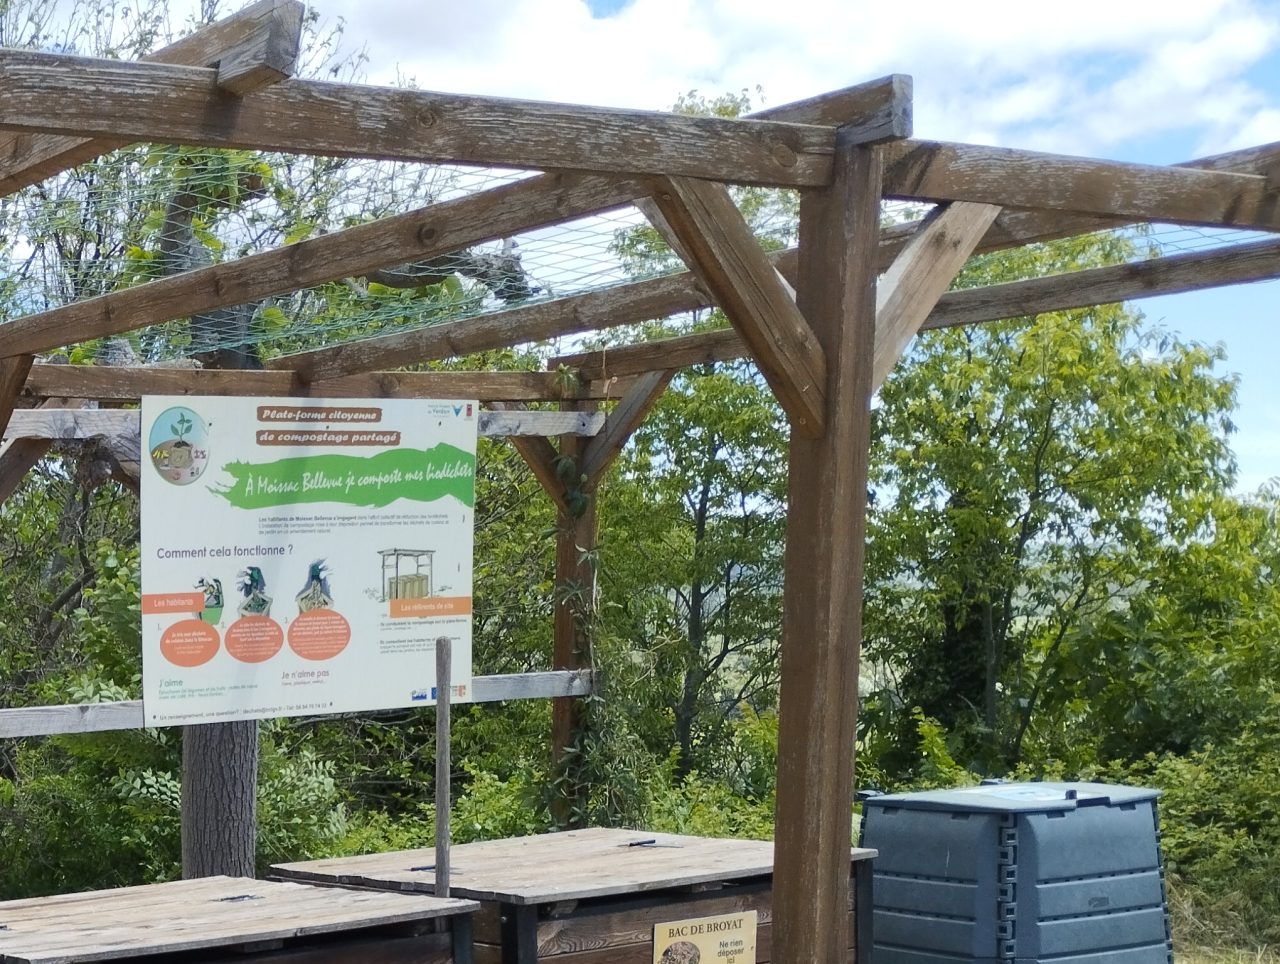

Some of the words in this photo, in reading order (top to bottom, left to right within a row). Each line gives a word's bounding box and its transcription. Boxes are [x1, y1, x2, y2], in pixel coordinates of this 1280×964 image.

[262, 410, 326, 420] Plate-forme
[328, 410, 377, 421] citoyenne
[259, 432, 274, 441] de
[277, 433, 348, 442] compostage
[352, 432, 397, 443] partagé
[245, 472, 254, 497] À
[257, 475, 299, 495] Moissac
[302, 471, 343, 492] Bellevue
[345, 471, 355, 494] je
[358, 468, 401, 489] composte
[405, 470, 423, 481] mes
[426, 460, 472, 480] biodéchets
[157, 547, 206, 559] Comment
[209, 546, 231, 557] cela
[234, 545, 285, 557] fonctionne
[288, 544, 293, 555] ?
[154, 599, 165, 607] Les
[167, 598, 193, 607] habitants
[282, 671, 289, 679] Je
[291, 670, 315, 678] n'aime
[317, 670, 329, 679] pas
[159, 678, 183, 688] J'aime
[668, 927, 688, 938] BAC
[690, 924, 704, 935] DE
[706, 918, 744, 933] BROYAT
[730, 939, 743, 947] rien
[717, 947, 745, 958] déposer
[726, 957, 735, 964] ici
